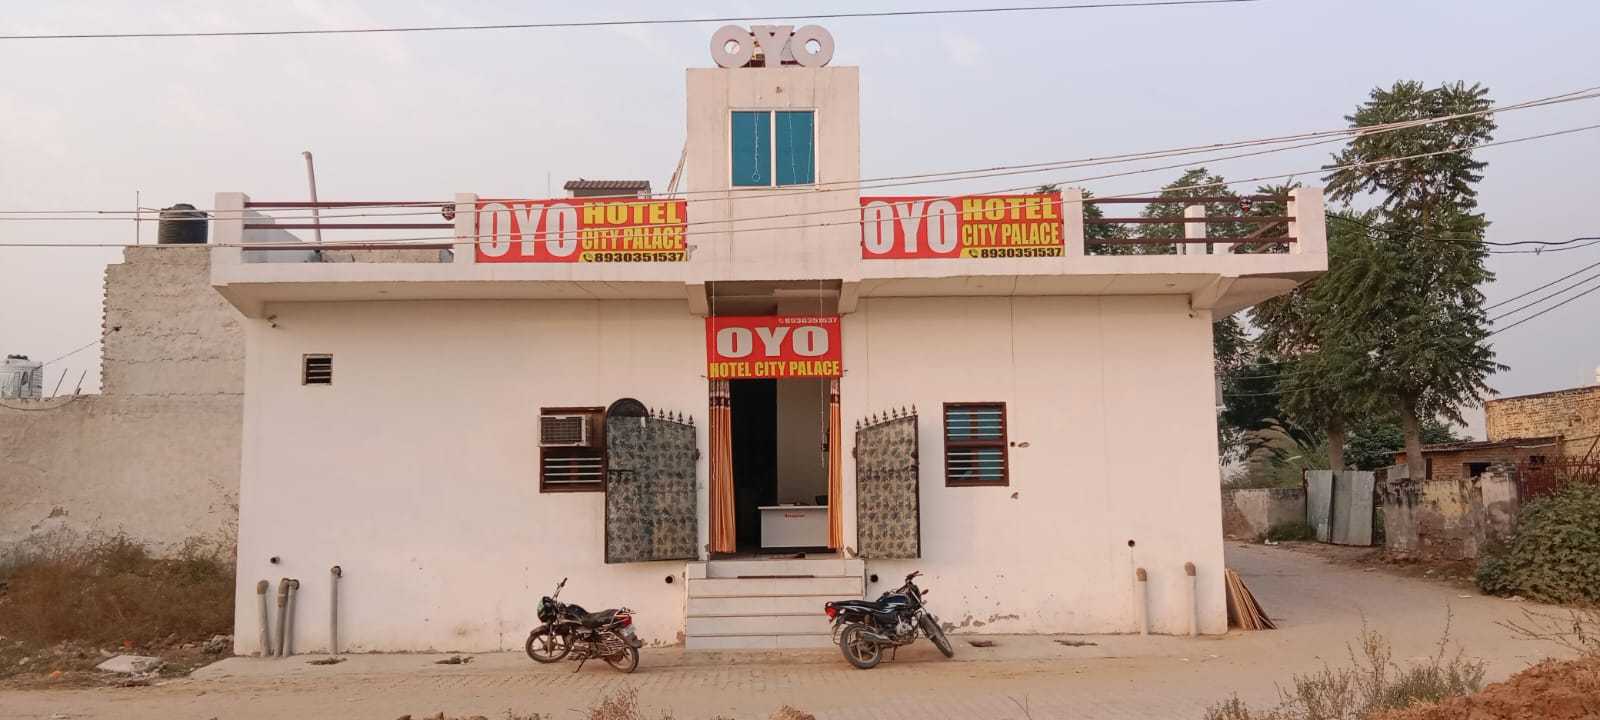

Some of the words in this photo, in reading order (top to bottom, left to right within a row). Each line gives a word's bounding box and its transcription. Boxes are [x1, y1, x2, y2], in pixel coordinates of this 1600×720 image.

[710, 25, 835, 68] OYO
[583, 201, 681, 225] HOTEL
[962, 198, 1056, 221] HOTEL
[479, 202, 577, 257] OYO
[582, 227, 618, 250] CITY
[624, 226, 682, 250] PALACE
[864, 200, 957, 254] OYO
[962, 224, 997, 246] CITY
[1002, 222, 1059, 245] PALACE
[594, 252, 684, 262] 8930351537
[981, 248, 1061, 258] 8930351537
[716, 325, 829, 358] OYO
[709, 362, 751, 378] HOTEL
[754, 361, 786, 376] CITY
[789, 360, 840, 376] PALACE
